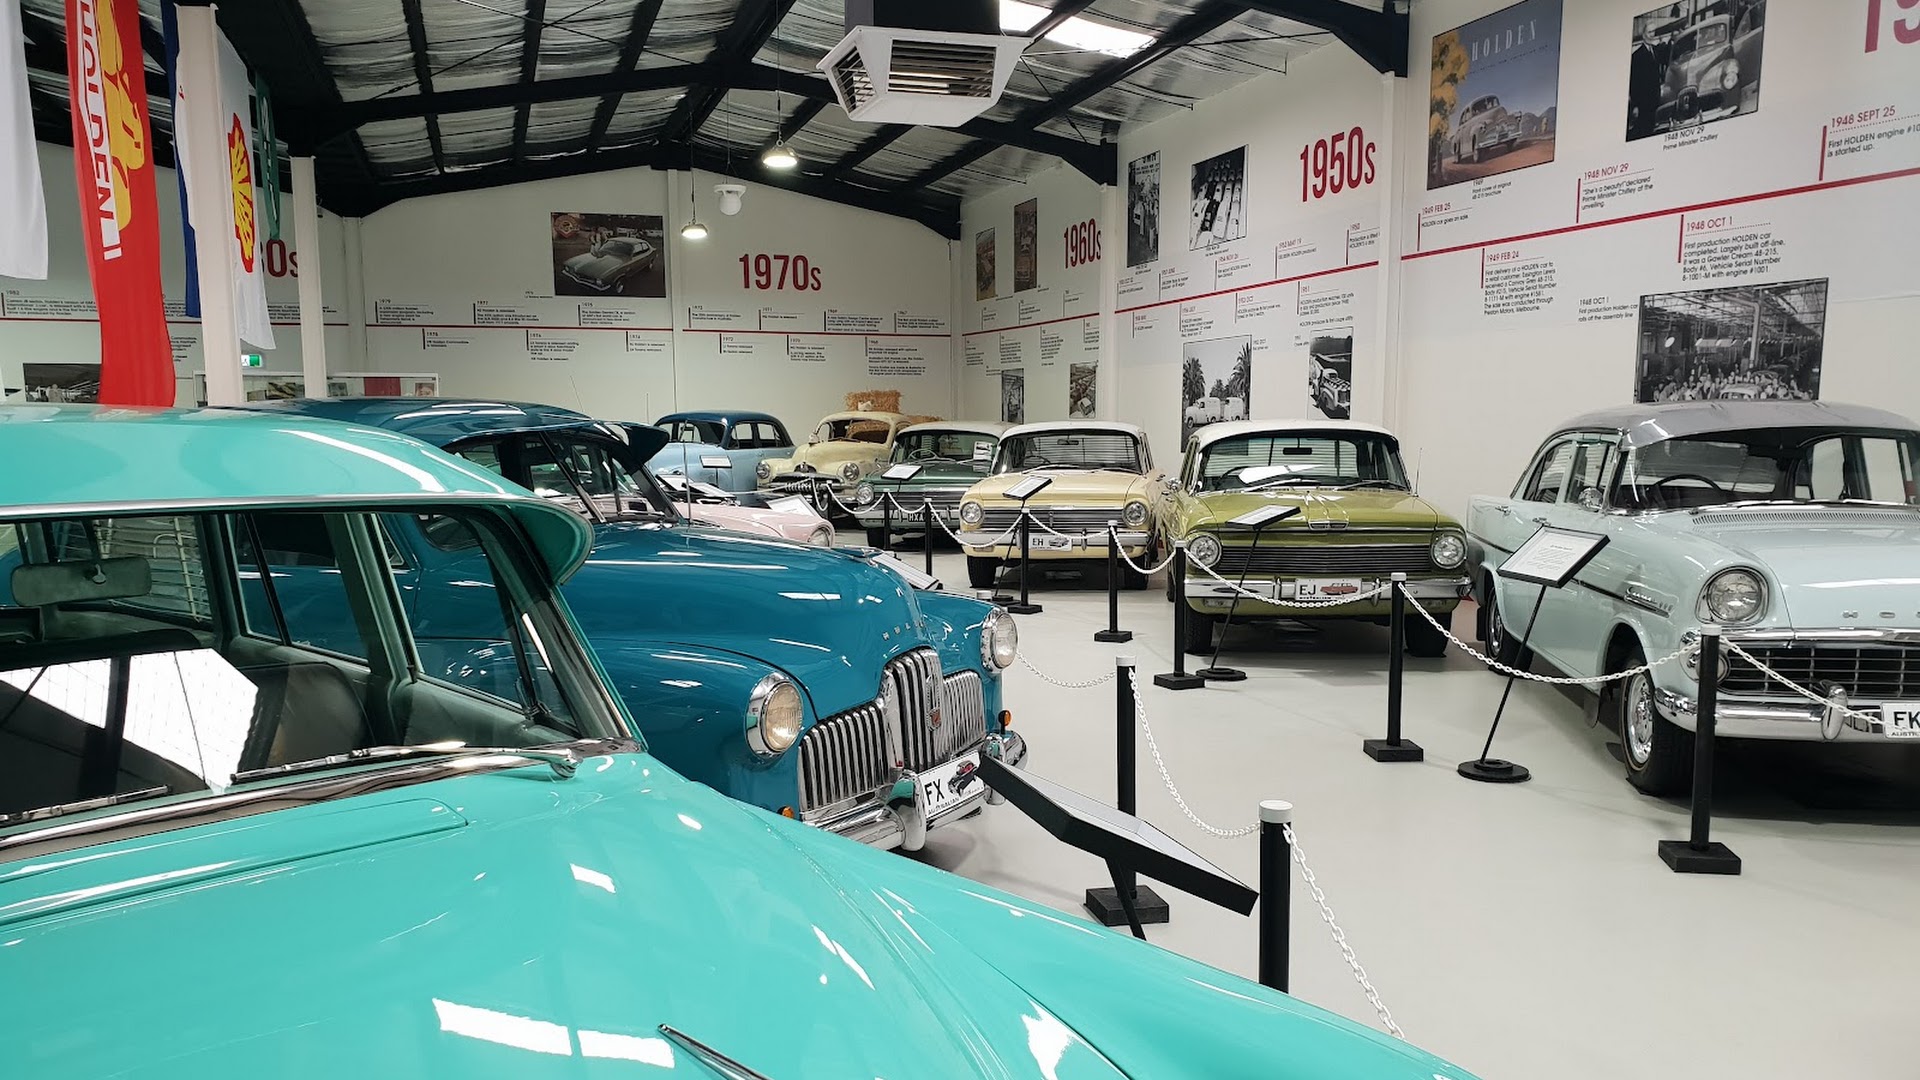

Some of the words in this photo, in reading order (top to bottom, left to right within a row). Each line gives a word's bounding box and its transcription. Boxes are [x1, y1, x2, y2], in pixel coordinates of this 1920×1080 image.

[1472, 19, 1536, 61] HOLDEN
[1831, 114, 1855, 128] 1948
[1857, 109, 1880, 122] SEPT
[1883, 105, 1895, 117] 25
[1664, 132, 1678, 142] 1948
[1680, 128, 1695, 138] NOV
[1697, 125, 1705, 134] 29
[1828, 139, 1842, 148] First
[1844, 132, 1875, 146] HOLDEN
[1877, 128, 1904, 139] engine
[1835, 145, 1861, 156] started
[1300, 126, 1376, 202] 1950s
[1584, 169, 1600, 180] 1948
[1602, 165, 1618, 176] NOV
[1620, 163, 1629, 172] 29
[1597, 191, 1617, 200] Minister
[1686, 220, 1705, 232] 1948
[1707, 216, 1727, 229] OCT
[1064, 218, 1101, 269] 1960s
[1684, 242, 1696, 250] First
[1697, 238, 1730, 249] production
[1732, 233, 1758, 243] HOLDEN
[1720, 244, 1743, 254] Largely
[1744, 241, 1759, 250] built
[1501, 252, 1509, 261] FEB
[1510, 251, 1519, 259] 24
[1707, 254, 1730, 263] Gawler
[1731, 252, 1753, 260] Cream
[739, 253, 822, 291] 1970s
[1683, 266, 1698, 274] Body
[1710, 262, 1733, 270] Vehicle
[1734, 259, 1752, 268] Serial
[1754, 257, 1781, 266] Number
[1726, 269, 1748, 277] engine
[1032, 538, 1044, 546] EH
[1300, 584, 1316, 596] EJ
[1893, 711, 1920, 729] FK
[924, 778, 945, 806] FX
